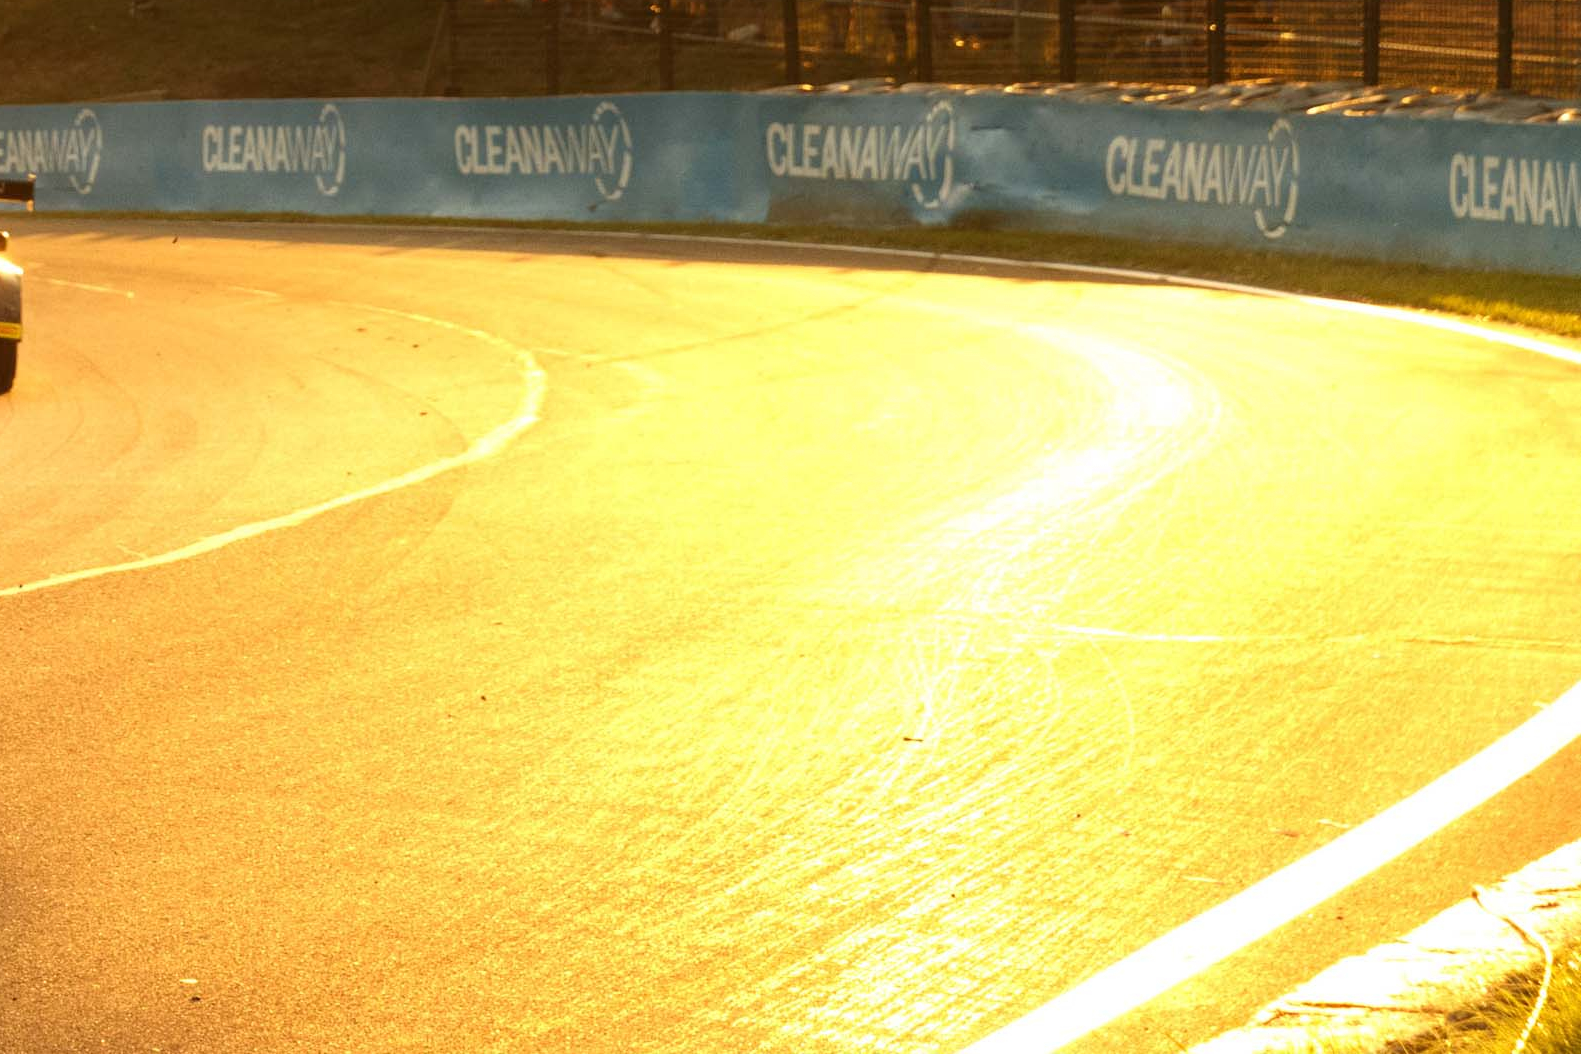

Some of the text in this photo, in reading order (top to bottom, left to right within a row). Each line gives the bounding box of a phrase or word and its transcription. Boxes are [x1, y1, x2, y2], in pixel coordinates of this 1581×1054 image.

[202, 124, 338, 172] CLEANAWAY
[454, 124, 619, 175] CLEANAWAY
[766, 121, 947, 180] CLEANAWAY
[1105, 135, 1290, 207] CLEANAWAY
